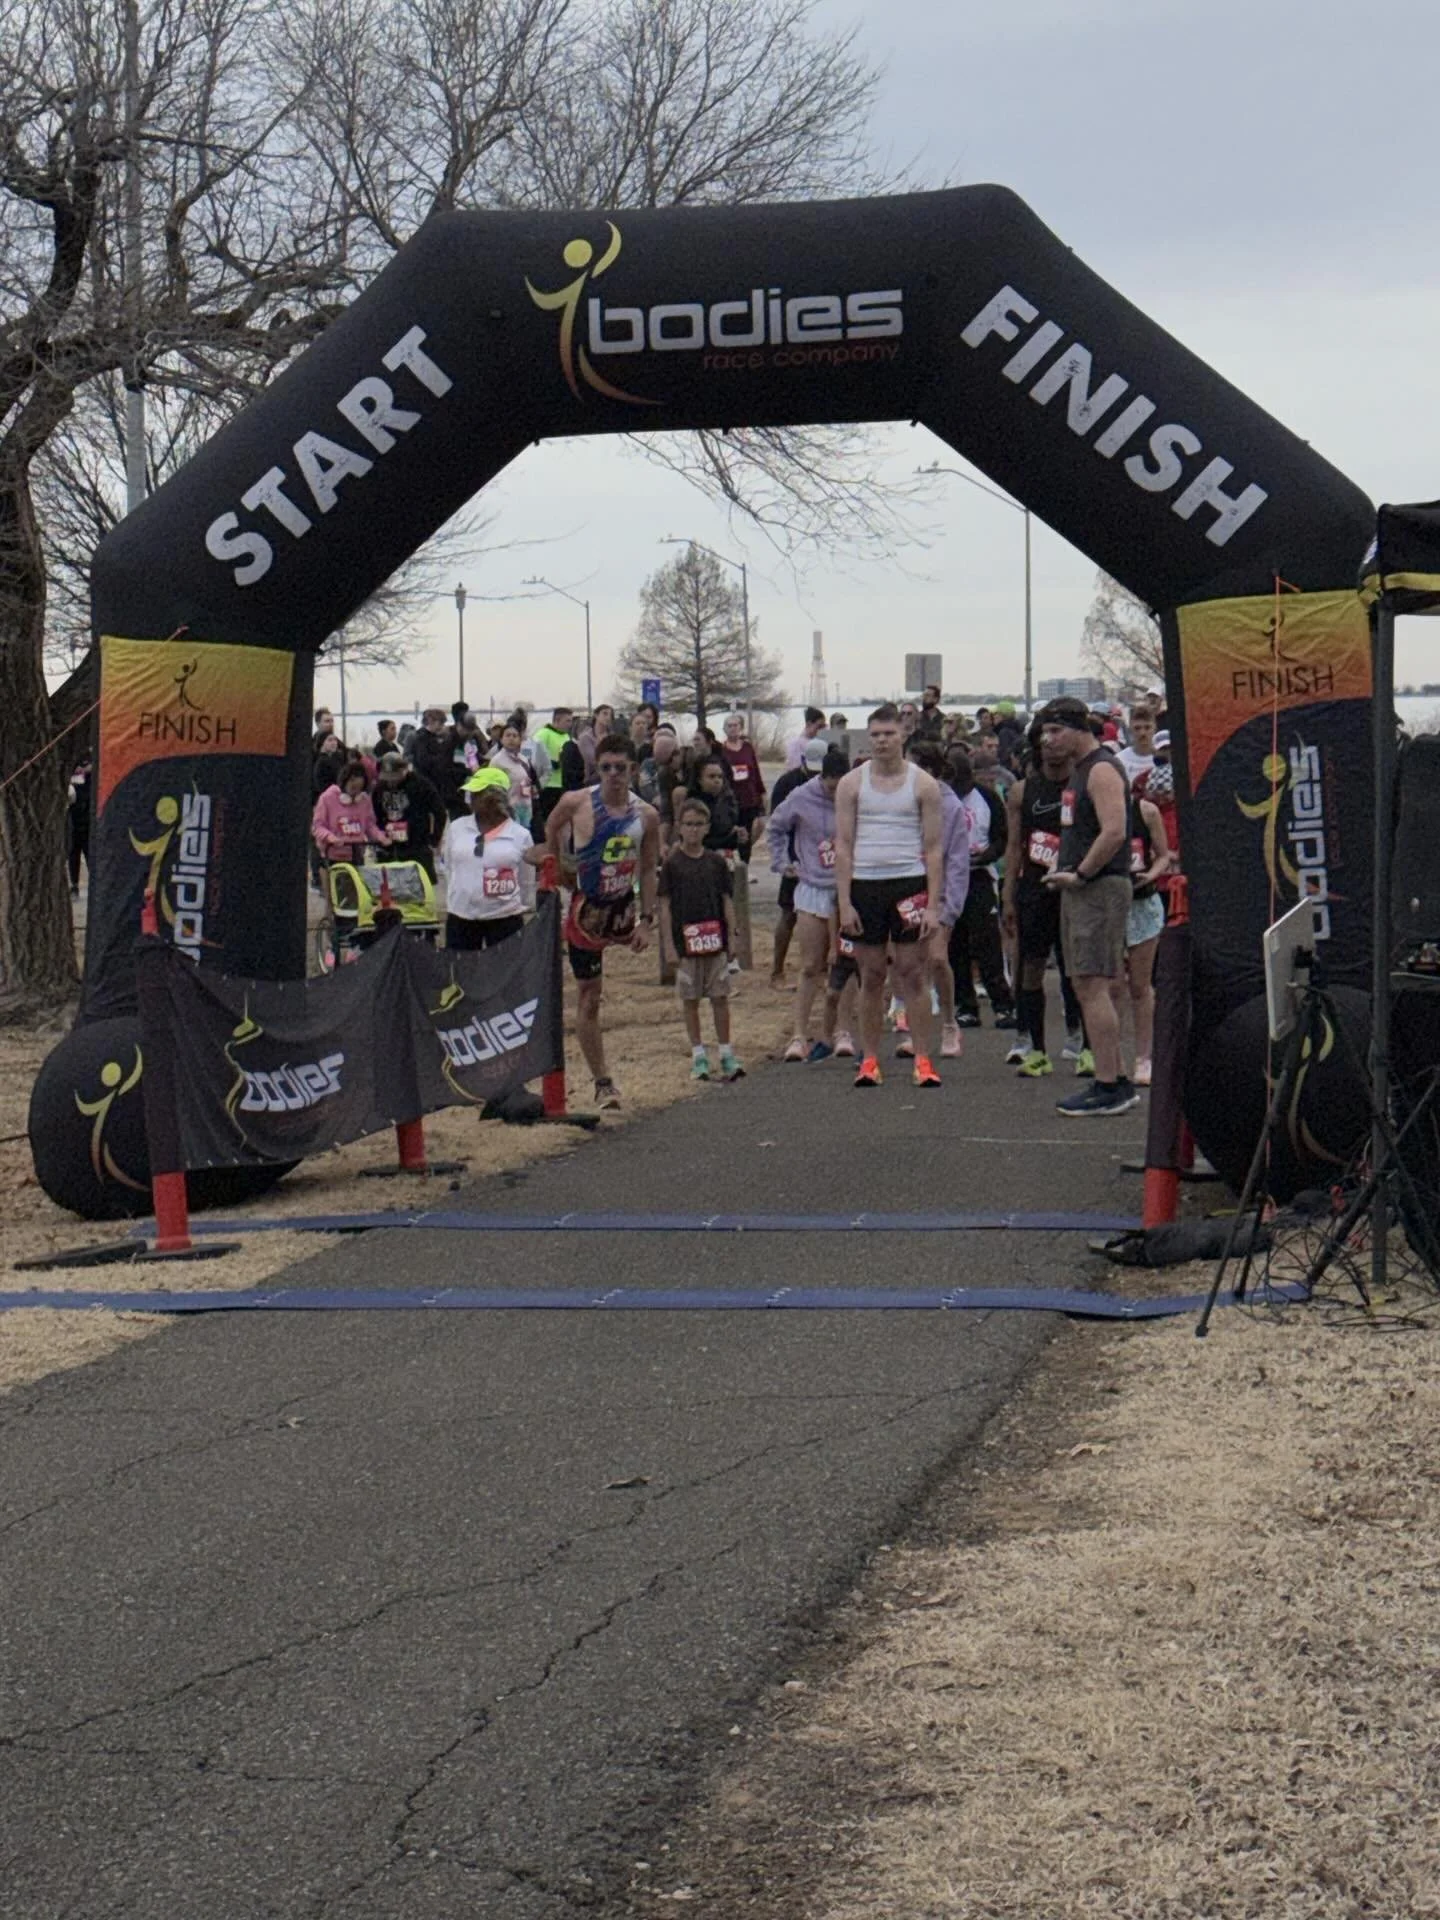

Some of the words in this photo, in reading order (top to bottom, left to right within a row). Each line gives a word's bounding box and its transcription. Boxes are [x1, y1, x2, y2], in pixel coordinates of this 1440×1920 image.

[587, 287, 904, 354] bodies
[702, 350, 765, 371] race
[773, 339, 900, 370] company
[959, 284, 1269, 548] FINISH
[204, 324, 454, 587] START
[1231, 664, 1335, 701] FINISH
[138, 711, 237, 746] FINISH
[688, 933, 722, 952] 1335
